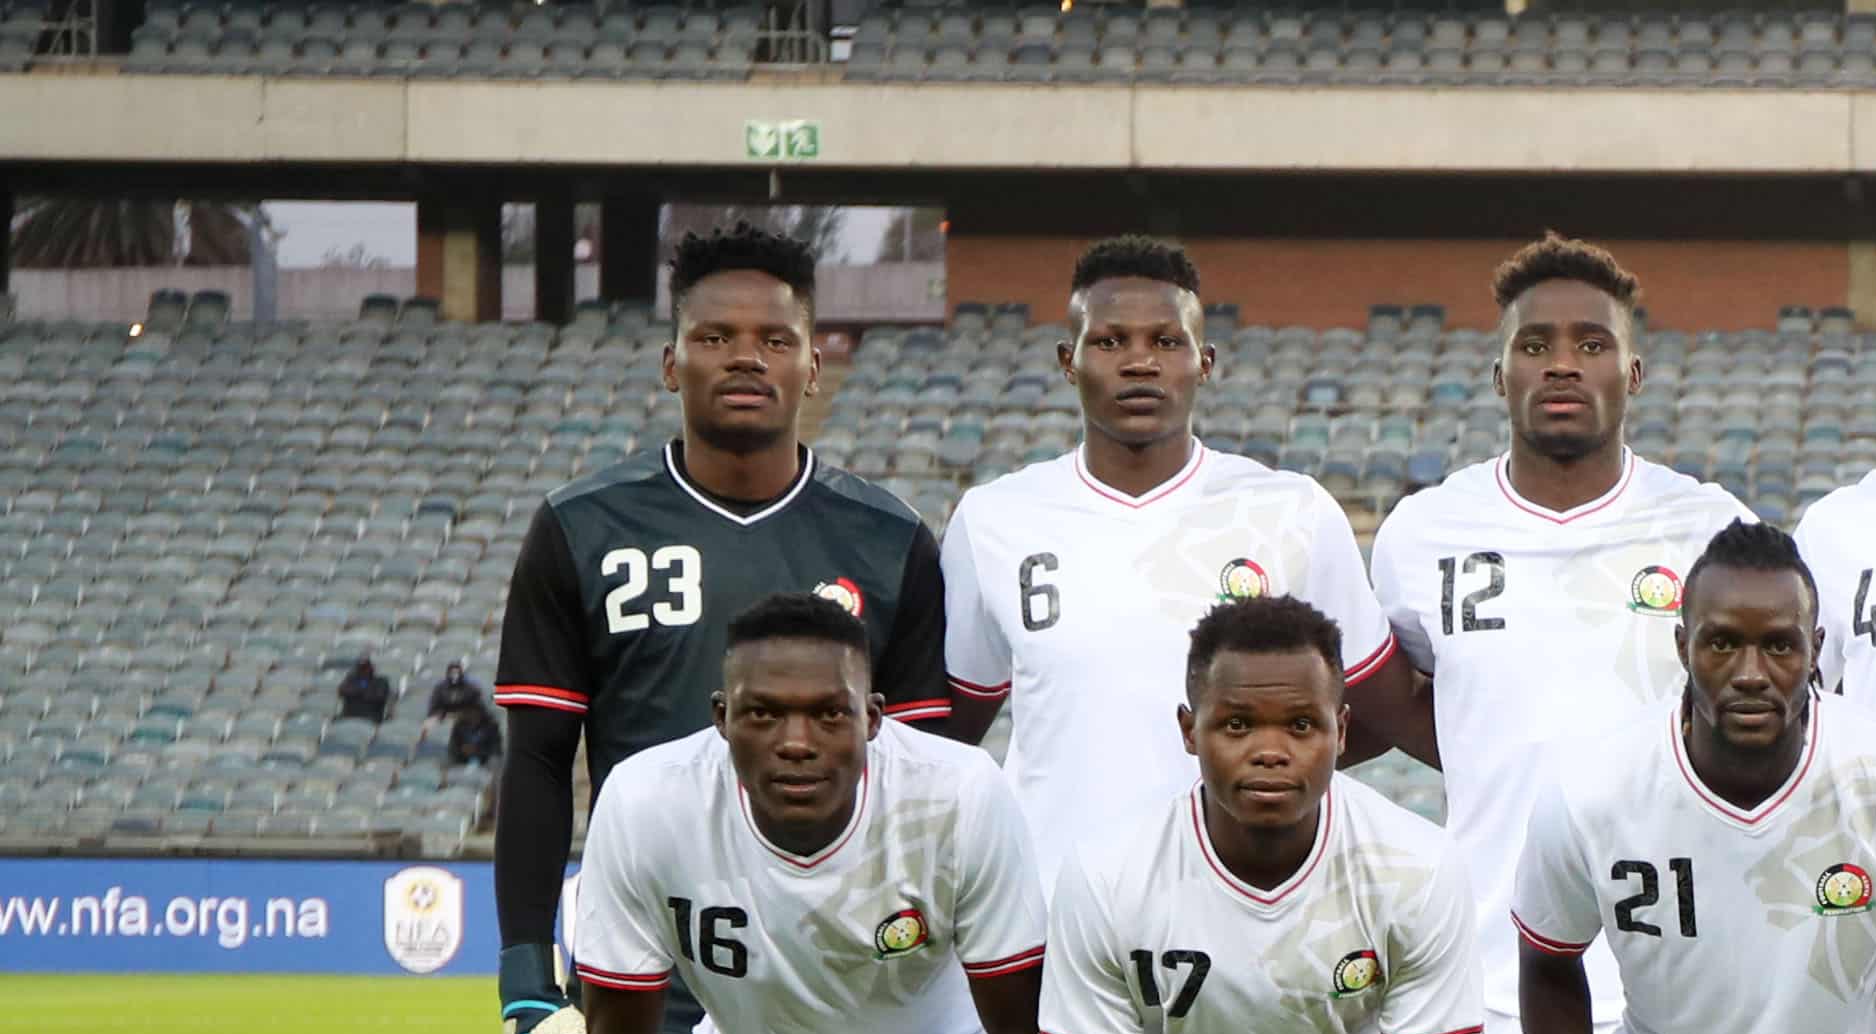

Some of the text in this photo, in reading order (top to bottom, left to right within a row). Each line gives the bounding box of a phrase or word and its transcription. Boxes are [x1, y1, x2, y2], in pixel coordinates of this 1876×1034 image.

[601, 544, 703, 634] 23
[1018, 551, 1061, 633] 6
[1438, 551, 1506, 636] 12
[668, 896, 748, 979] 16
[1610, 857, 1698, 938] 21
[1130, 949, 1211, 1018] 17
